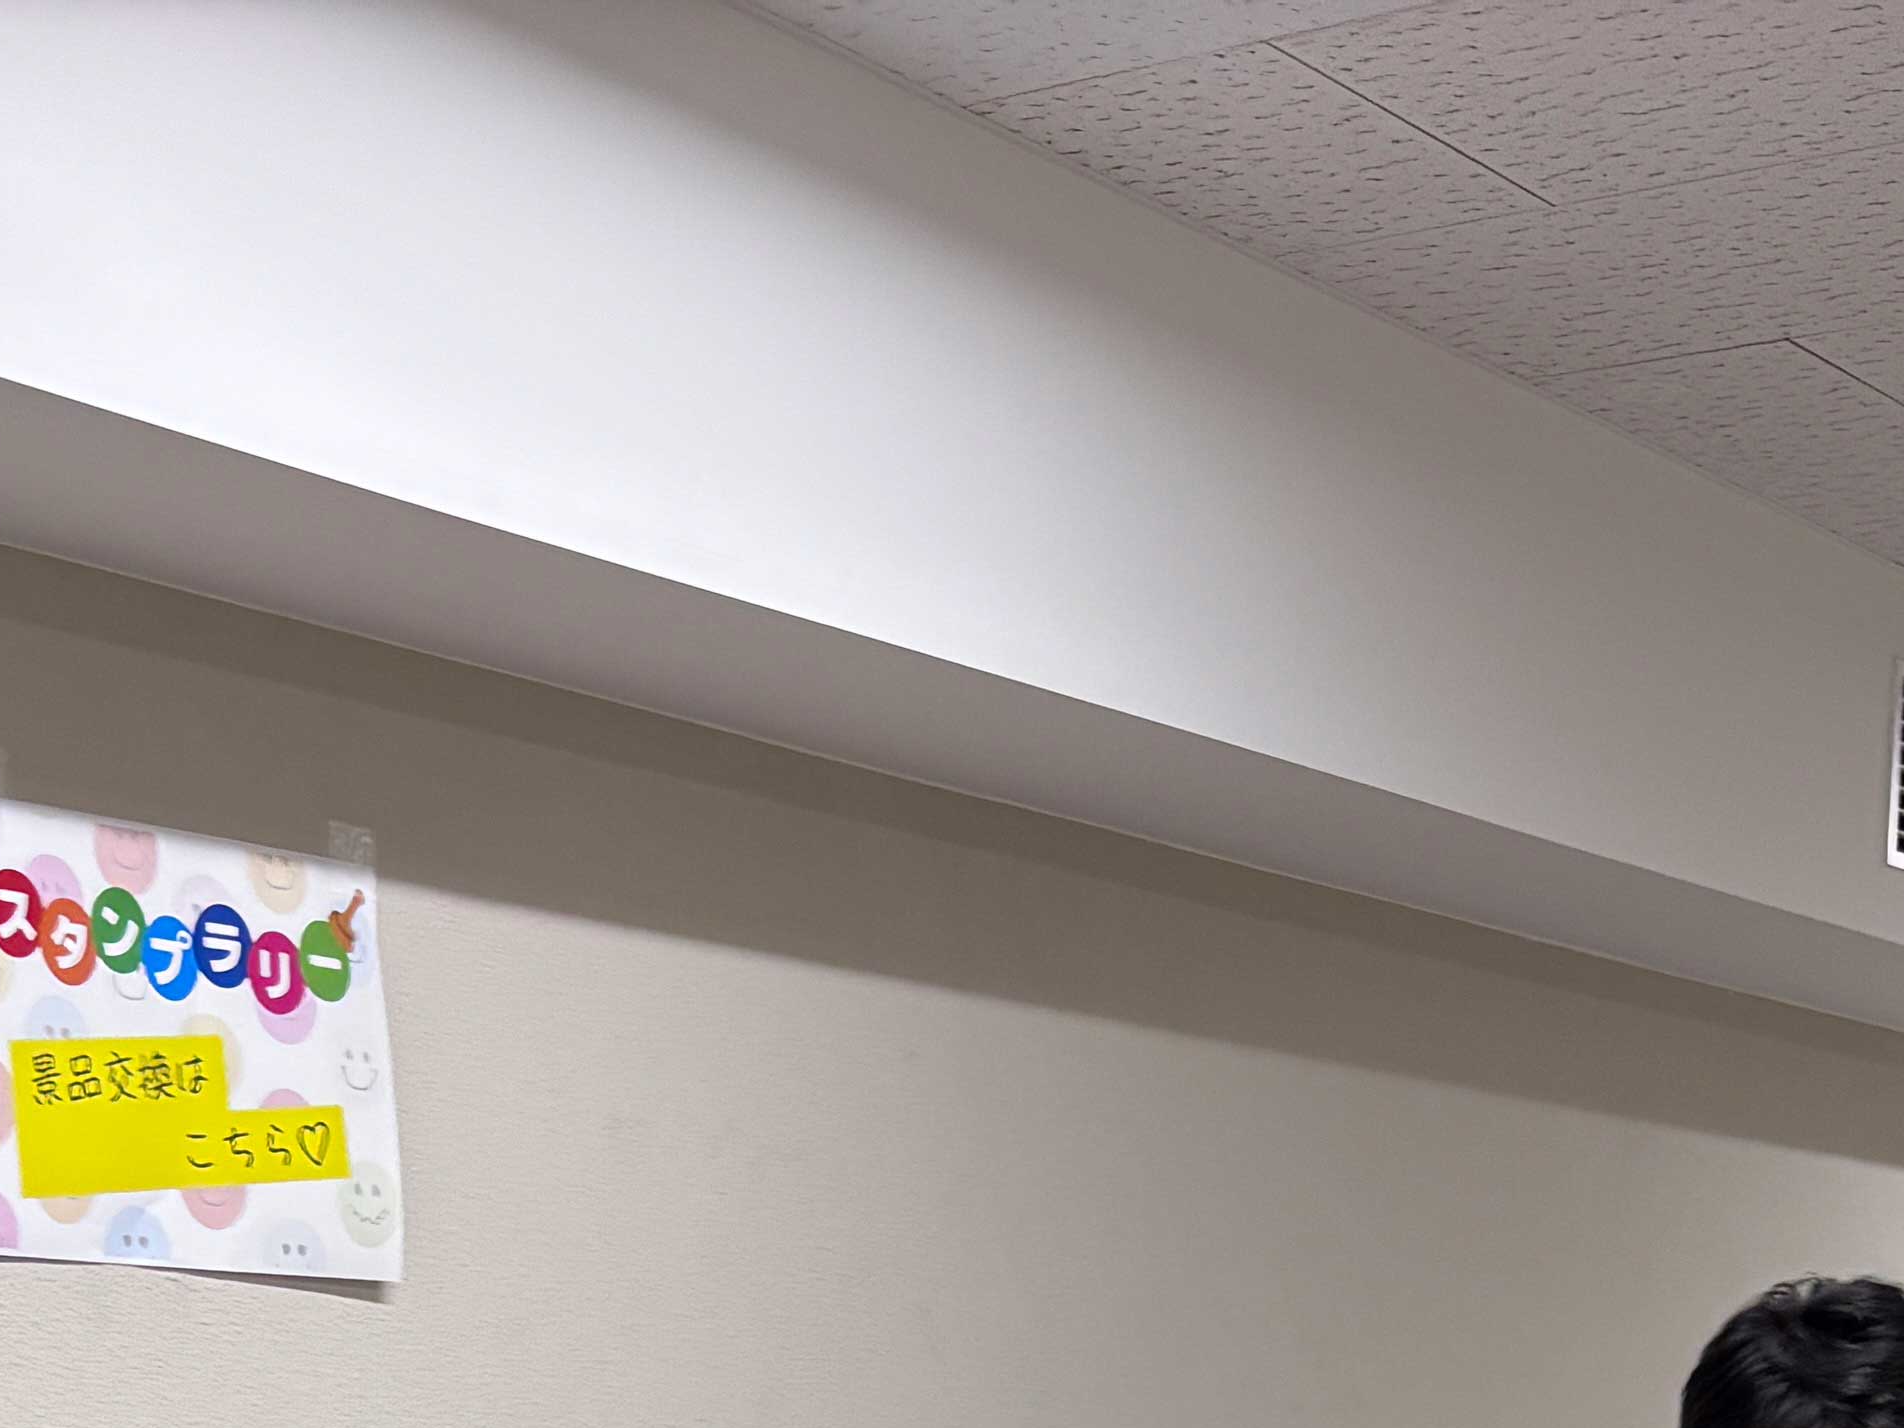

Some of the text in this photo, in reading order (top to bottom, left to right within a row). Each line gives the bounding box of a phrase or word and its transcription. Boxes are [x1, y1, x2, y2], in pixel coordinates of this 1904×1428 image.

[30, 1050, 208, 1106] 景品交換は
